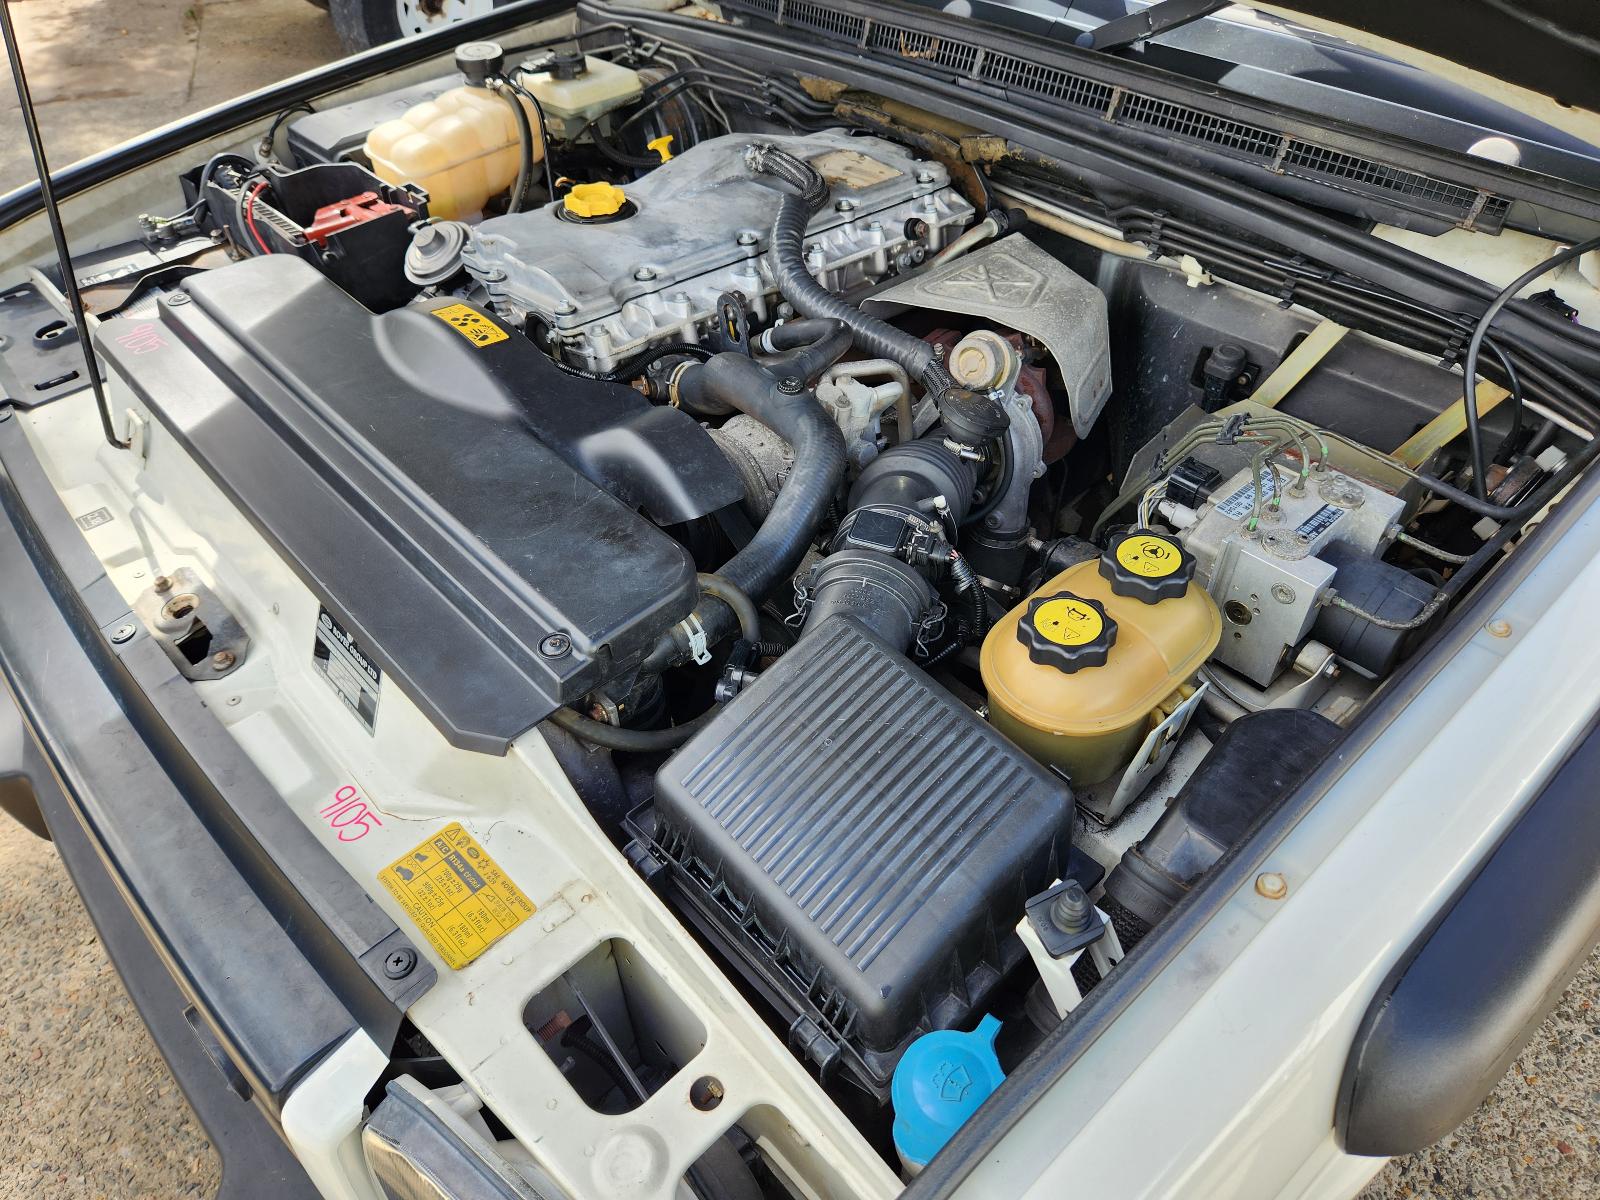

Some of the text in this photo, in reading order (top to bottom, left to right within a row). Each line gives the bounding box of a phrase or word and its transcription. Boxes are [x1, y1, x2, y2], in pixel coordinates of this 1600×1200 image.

[332, 626, 377, 680] ROVER GROUP LTD
[320, 786, 382, 841] 9105
[412, 902, 436, 928] CAUTION
